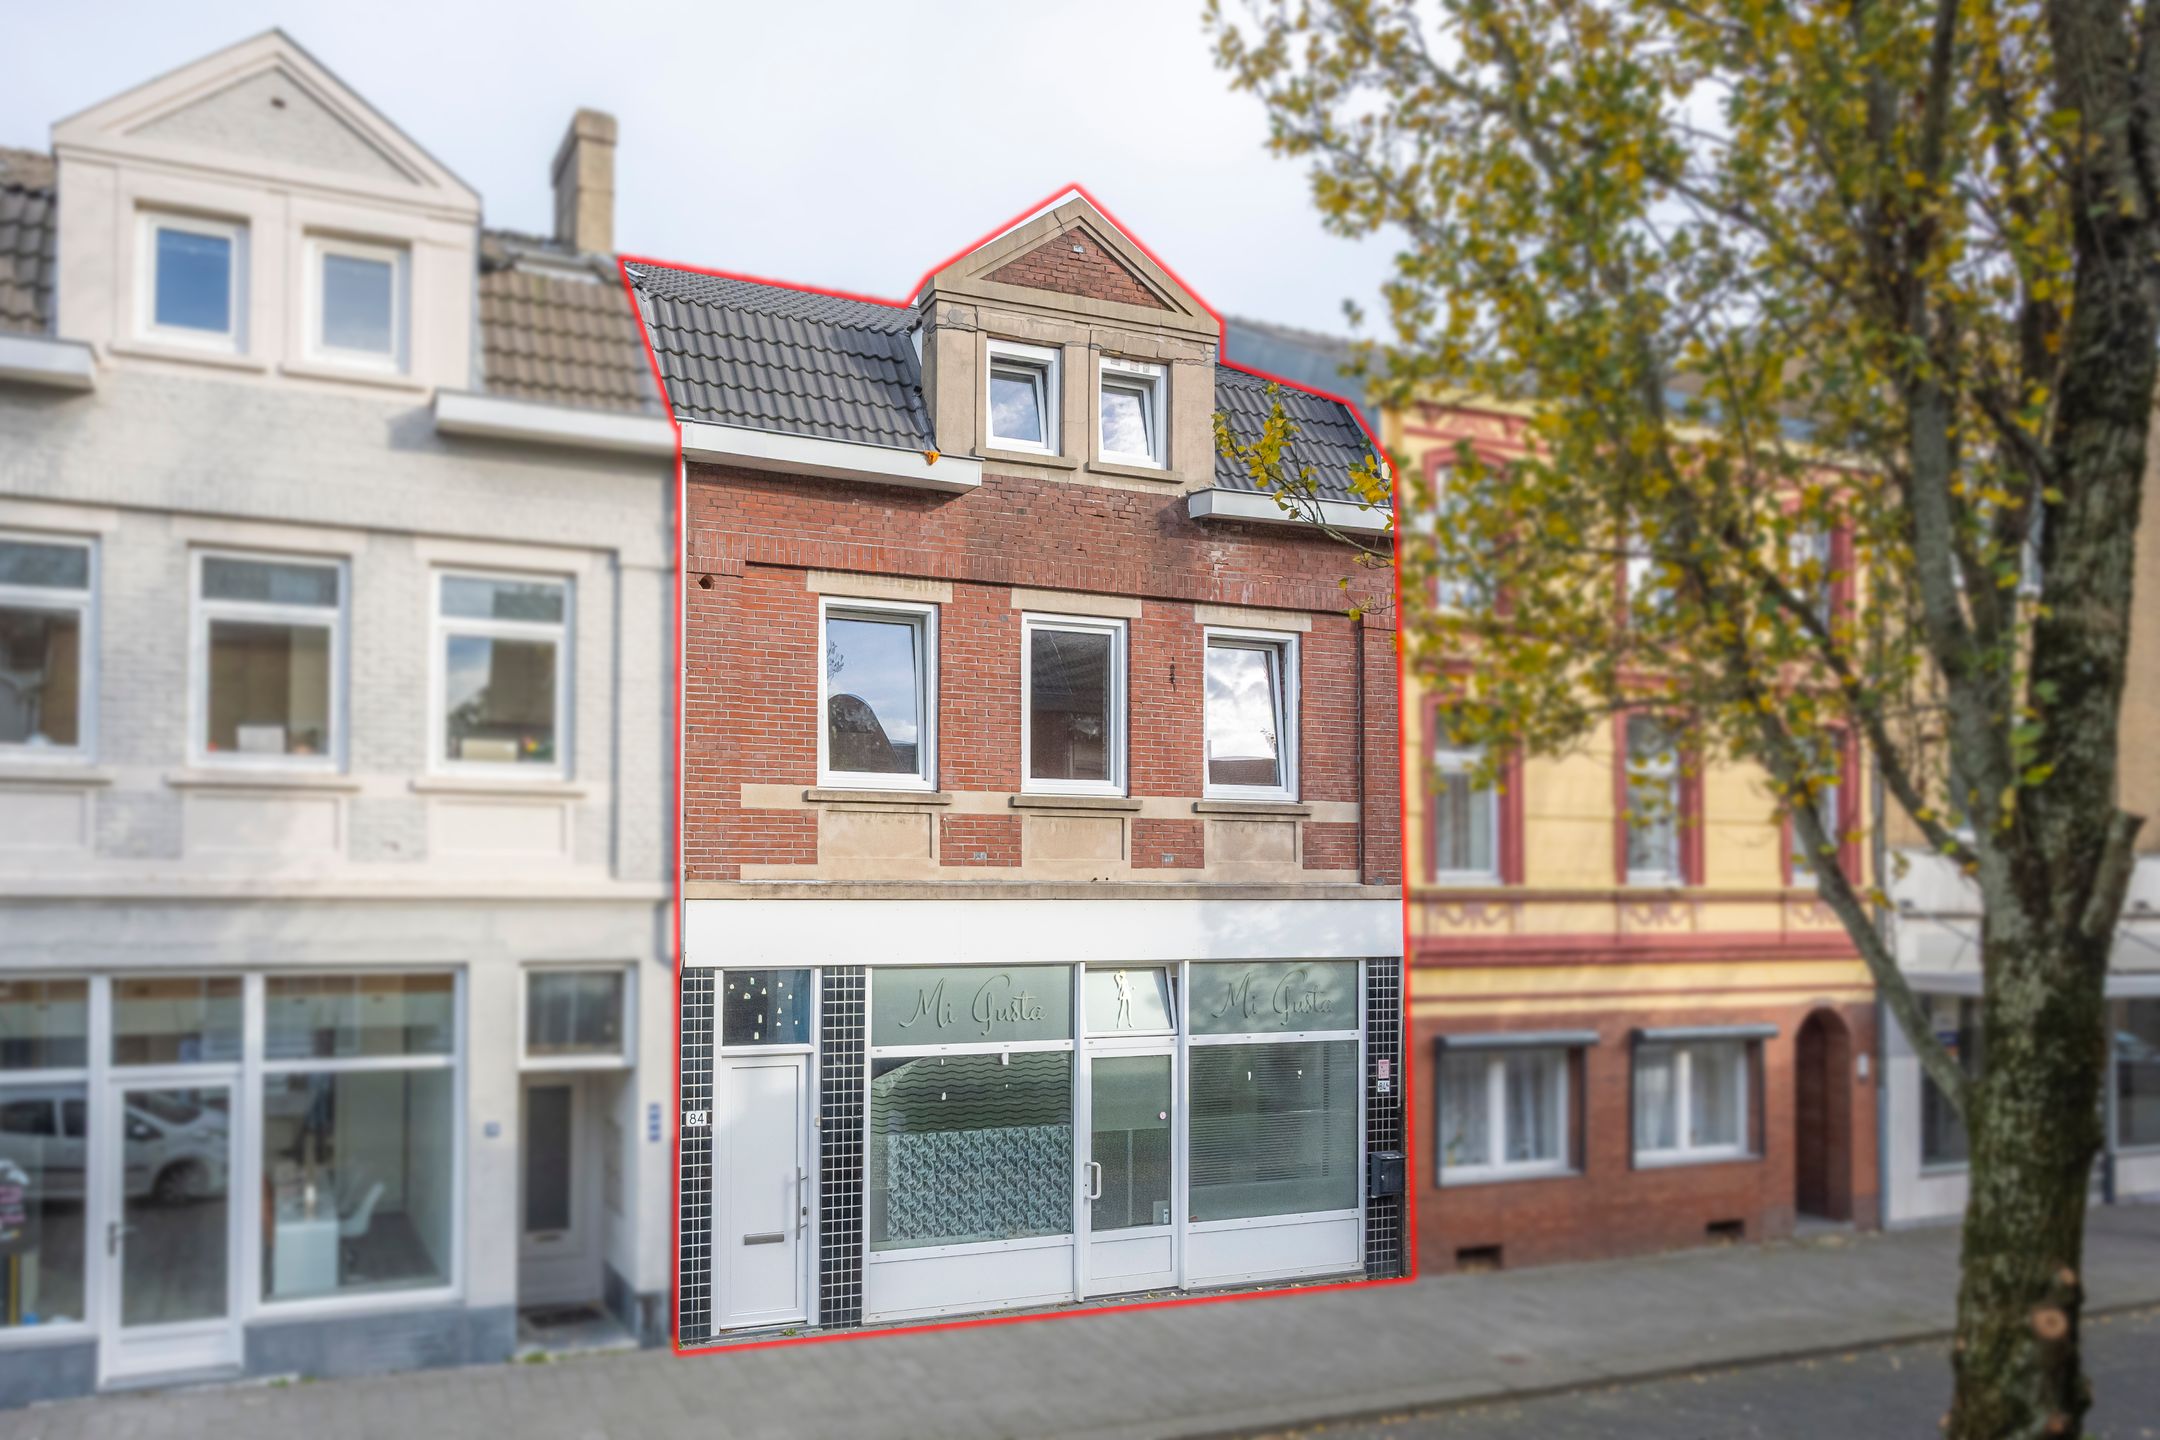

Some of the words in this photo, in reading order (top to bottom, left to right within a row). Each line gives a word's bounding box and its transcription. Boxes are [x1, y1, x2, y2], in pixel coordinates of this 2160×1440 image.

[898, 976, 956, 1028] Mi
[1210, 972, 1258, 1019] Mi
[689, 1113, 705, 1125] 84
